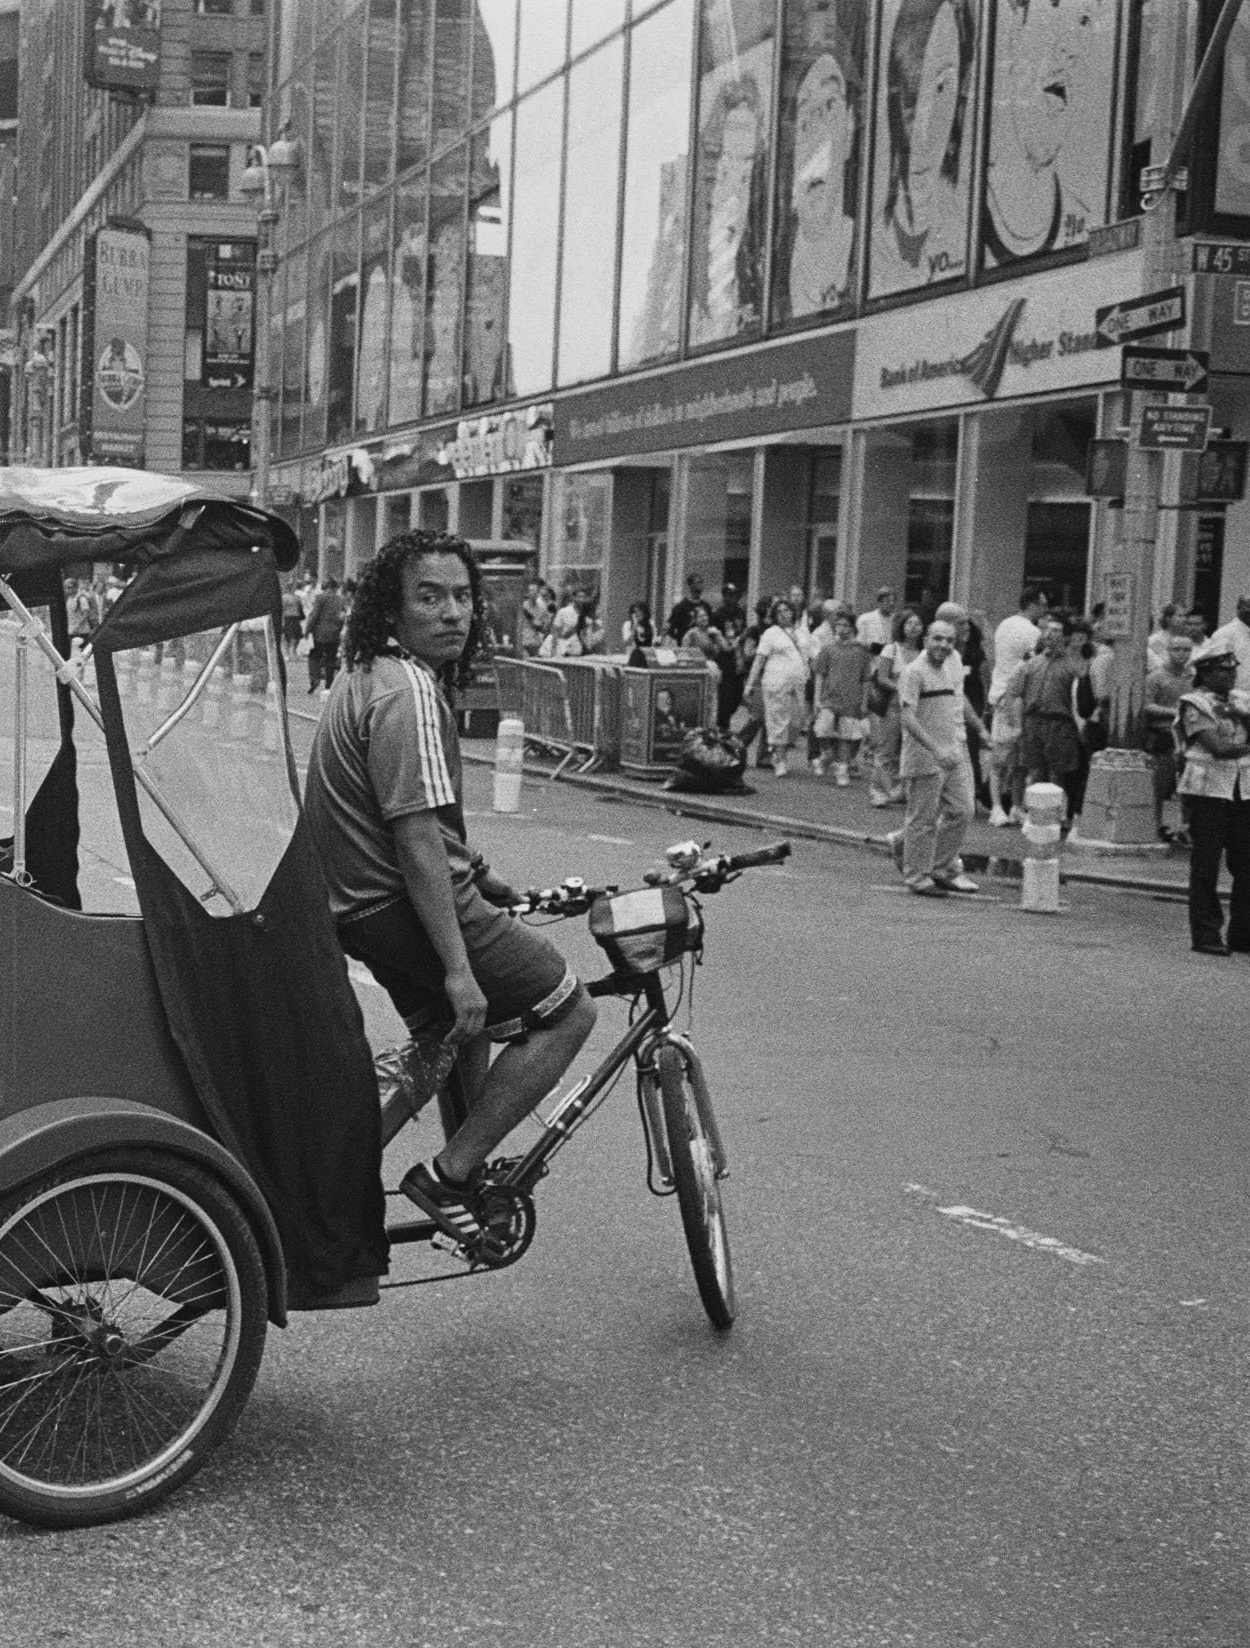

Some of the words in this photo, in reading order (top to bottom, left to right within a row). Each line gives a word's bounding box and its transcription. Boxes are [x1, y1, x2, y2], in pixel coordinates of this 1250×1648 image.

[1196, 246, 1210, 270] W
[1213, 247, 1233, 272] 45
[1107, 314, 1131, 334] ONE
[1148, 304, 1174, 323] WAY
[1133, 361, 1158, 377] ONE
[1174, 362, 1198, 378] WAY
